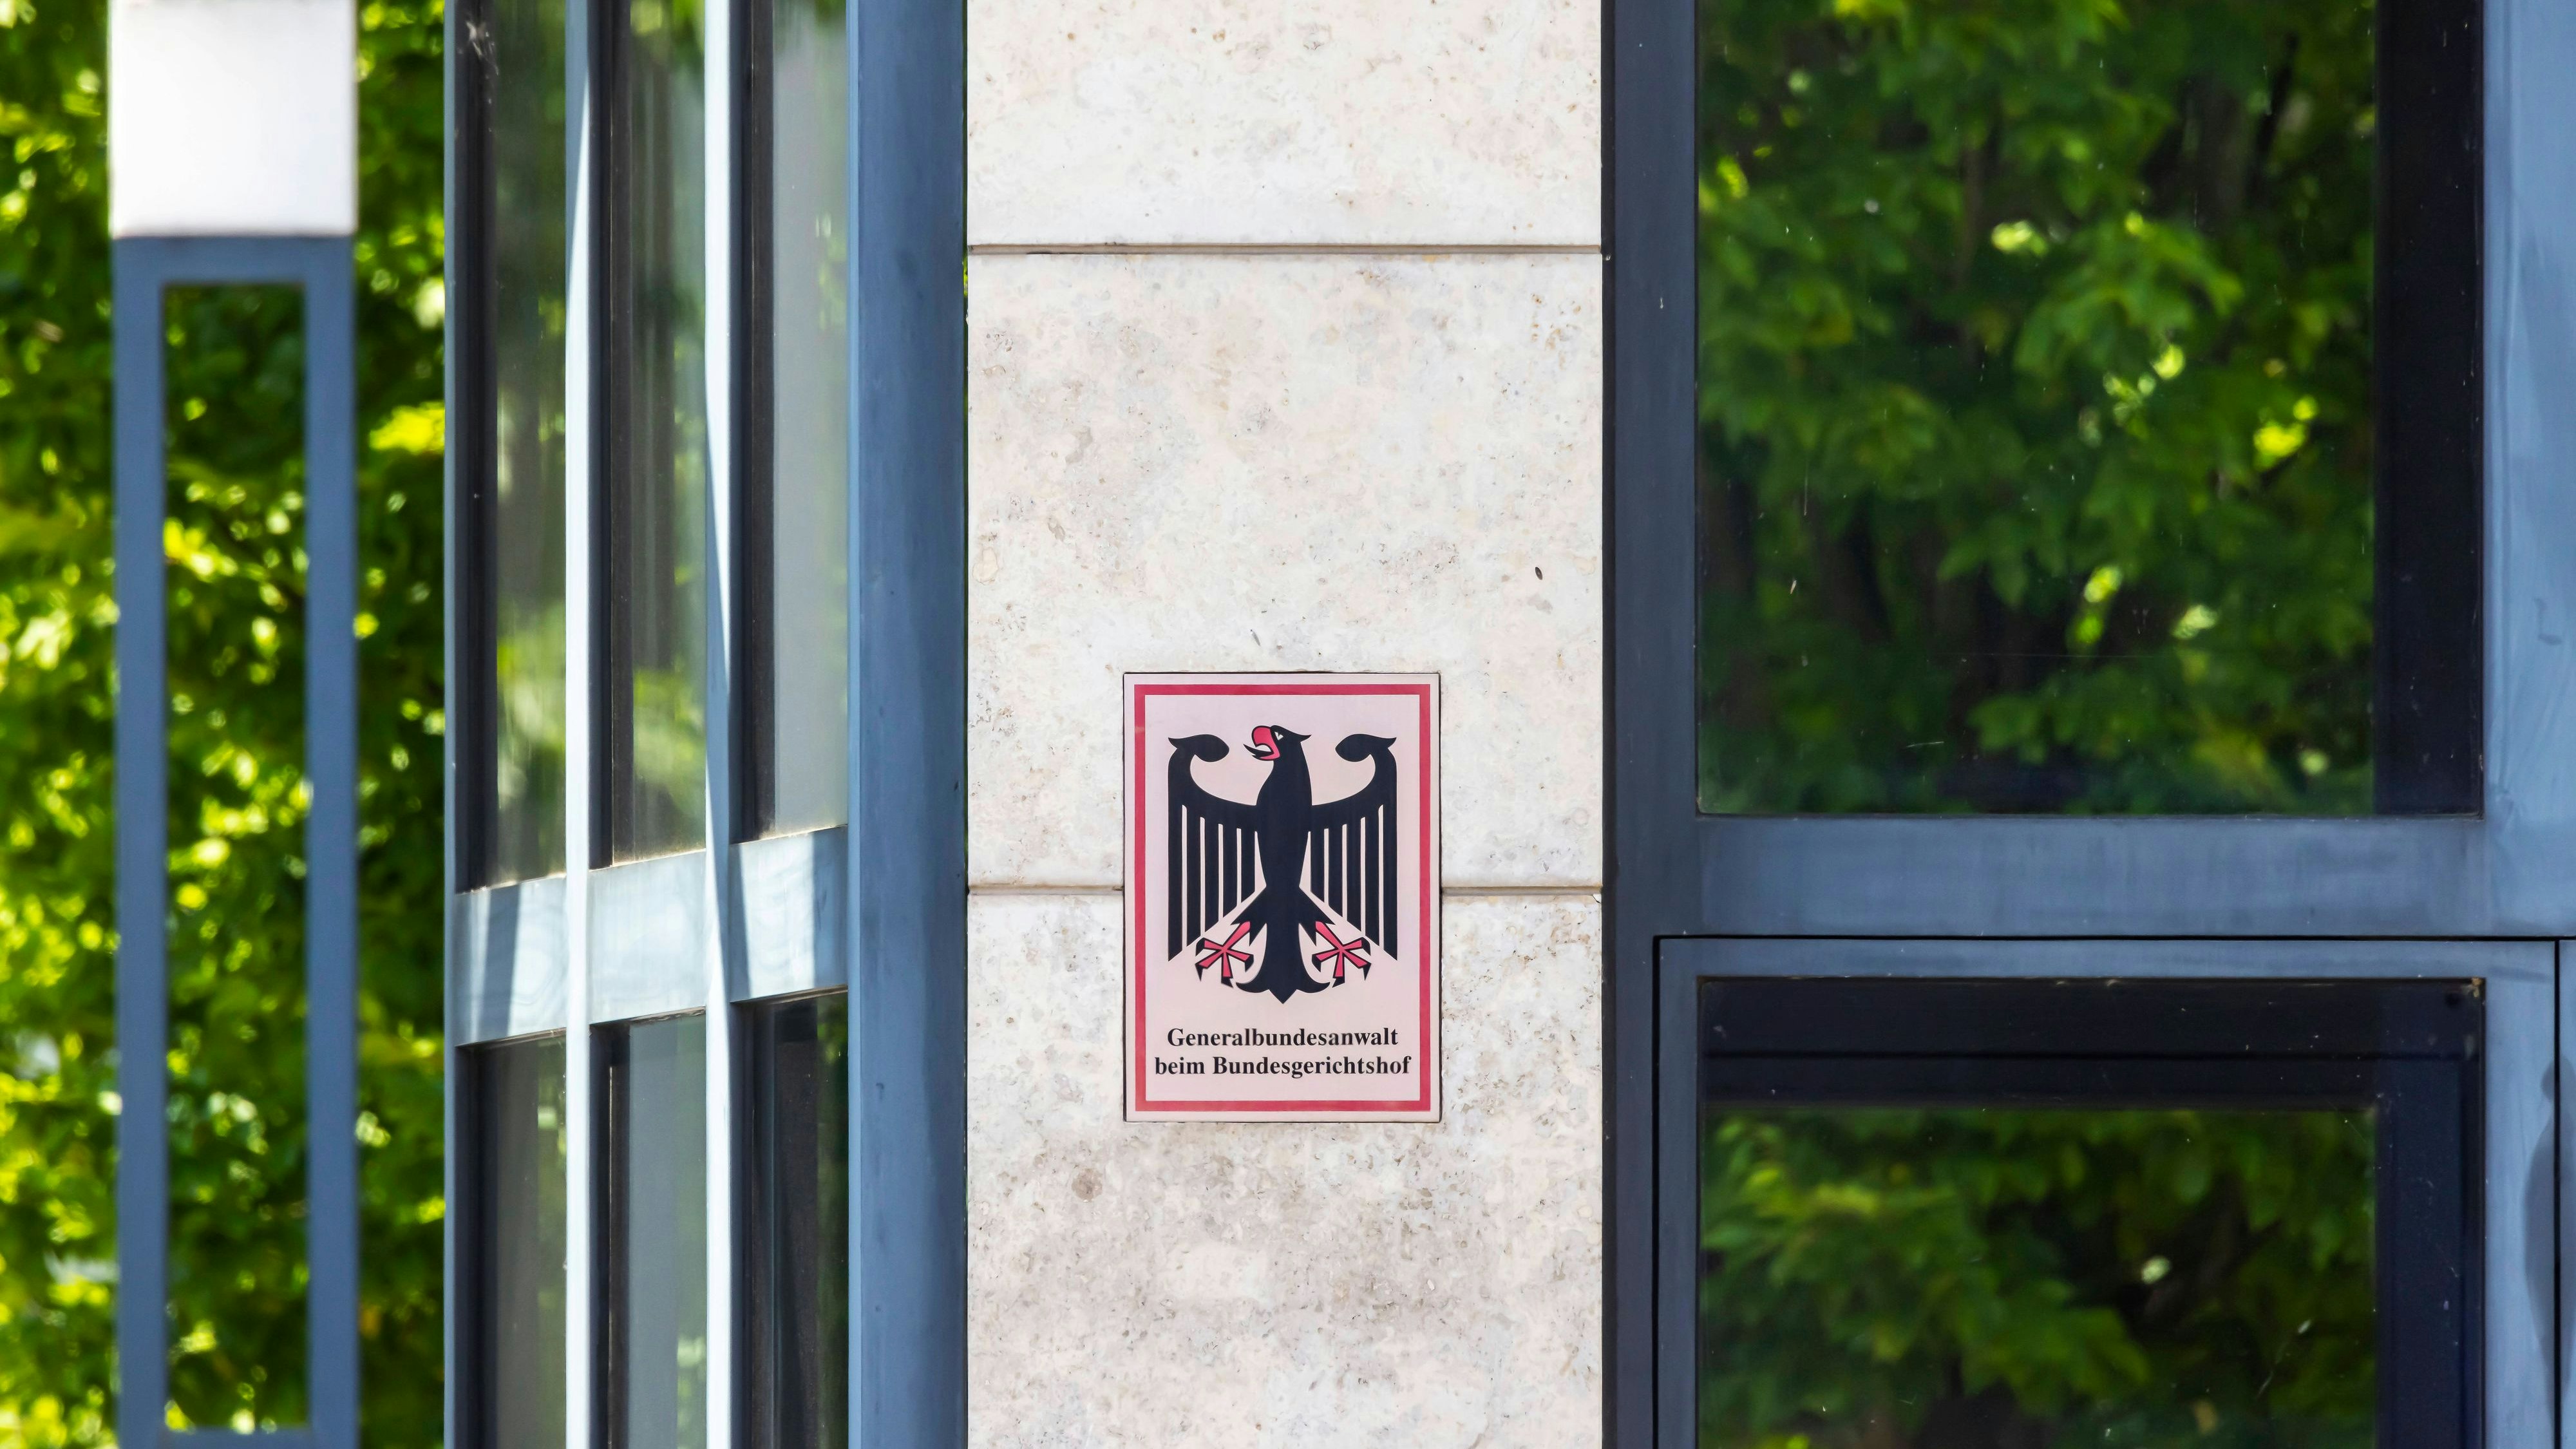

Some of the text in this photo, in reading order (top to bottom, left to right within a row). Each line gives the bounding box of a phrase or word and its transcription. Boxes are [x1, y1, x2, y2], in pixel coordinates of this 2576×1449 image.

[1167, 1028, 1399, 1046] Generalbundesanwalt
[1155, 1056, 1412, 1079] beim Bundesgerichtshof
